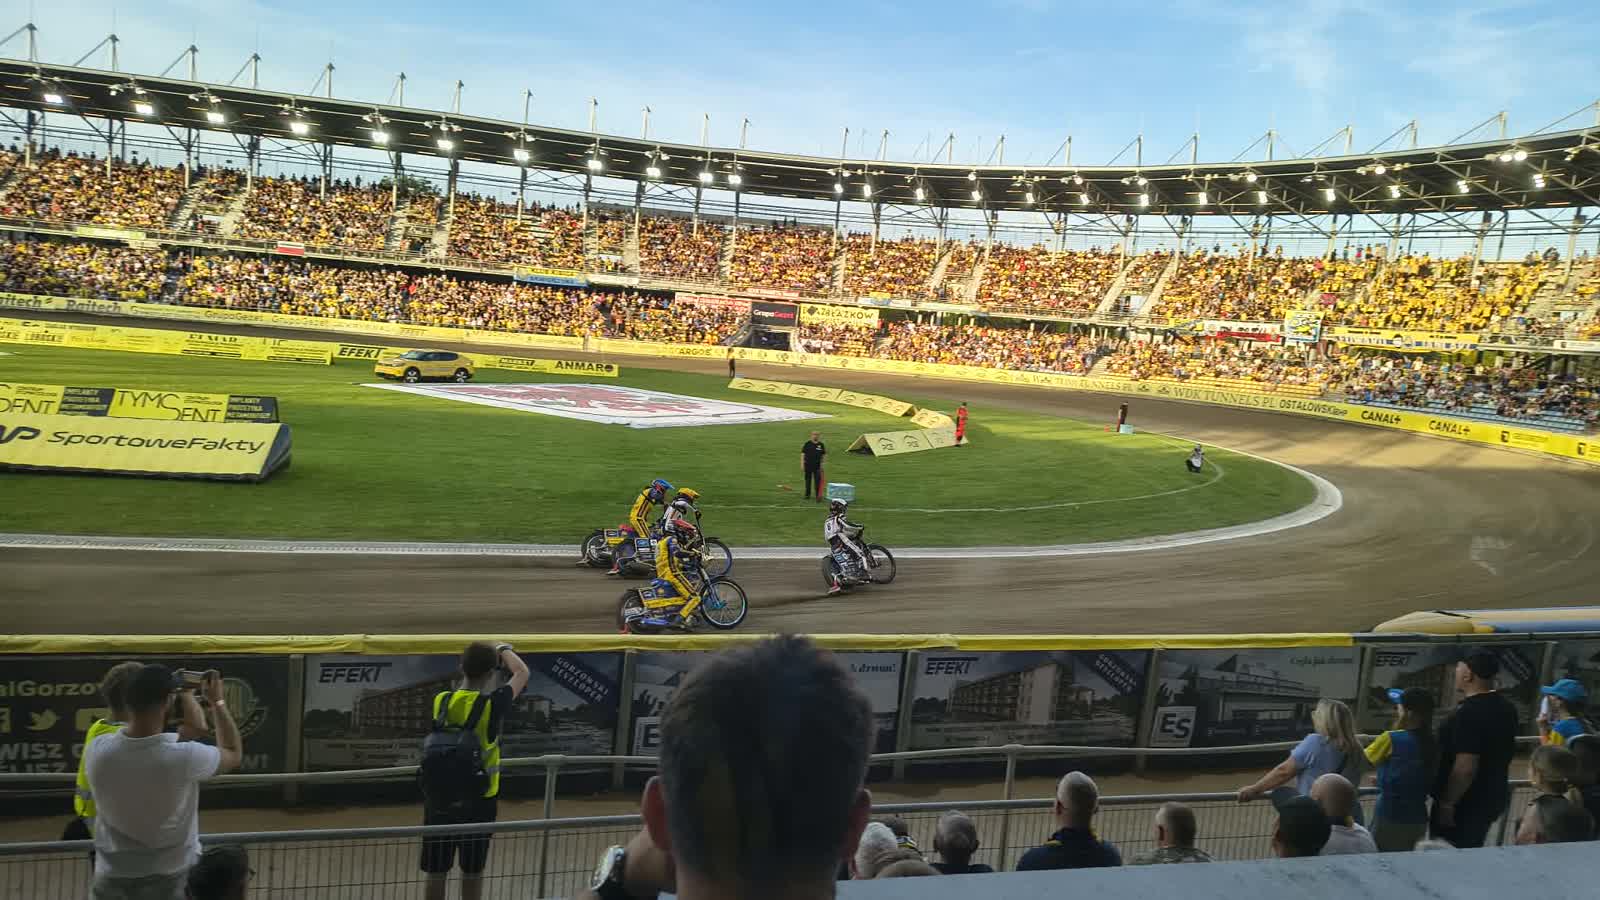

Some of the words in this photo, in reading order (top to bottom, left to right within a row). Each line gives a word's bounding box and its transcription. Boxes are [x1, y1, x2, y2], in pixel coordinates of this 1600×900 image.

[339, 345, 385, 358] EFEKT
[1360, 410, 1401, 425] CANAL+
[1428, 420, 1470, 436] CANAL+
[47, 431, 265, 454] SportoweFakty
[319, 663, 390, 683] EFEKT
[925, 658, 977, 675] EFEKT
[0, 680, 104, 697] alGorzo
[1160, 712, 1192, 739] ES
